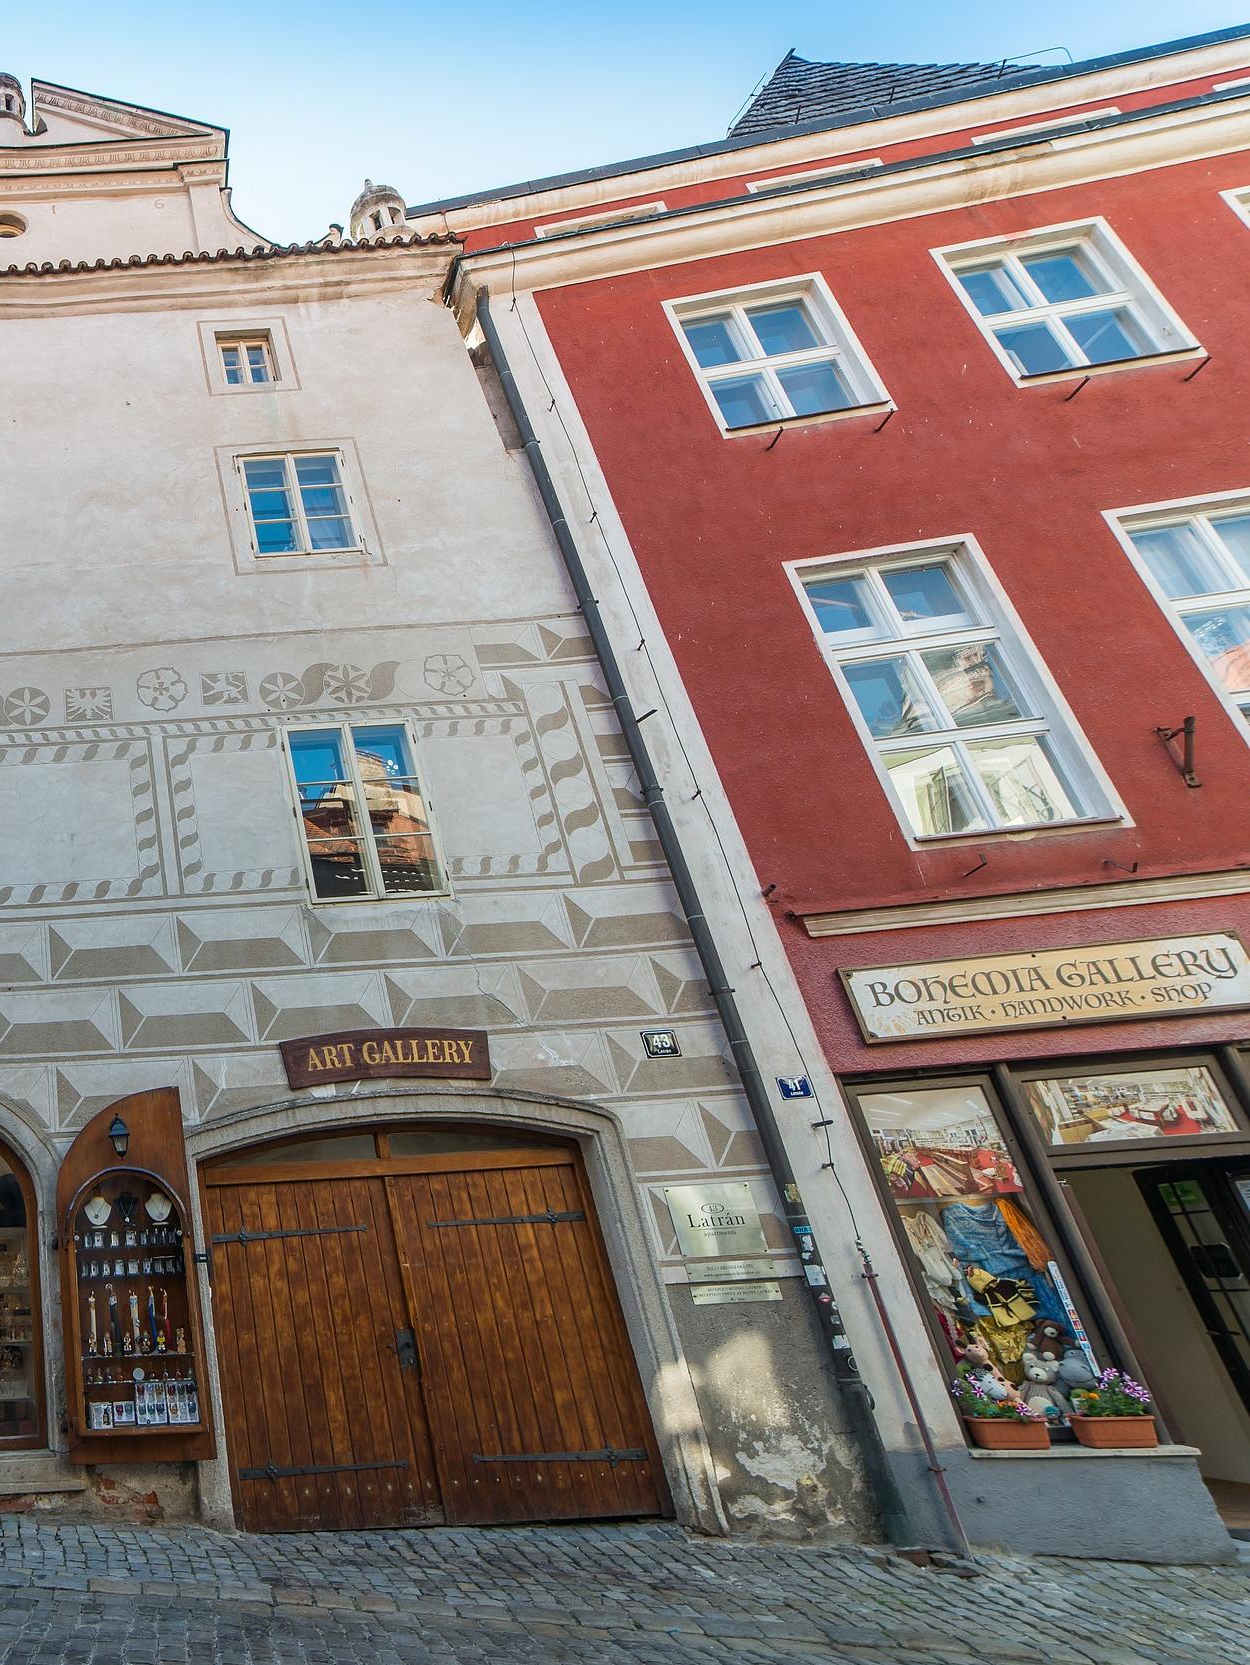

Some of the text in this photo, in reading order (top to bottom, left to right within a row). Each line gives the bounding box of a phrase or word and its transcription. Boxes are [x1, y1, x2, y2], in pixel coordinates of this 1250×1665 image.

[864, 947, 1239, 1008] BOHEMIA GALLERY
[913, 981, 1212, 1025] ANTIK HANDWORK SHOP
[653, 1034, 670, 1048] 43
[307, 1039, 473, 1071] ART GALLERY
[687, 1212, 745, 1228] Latrán
[704, 1230, 737, 1238] apartments
